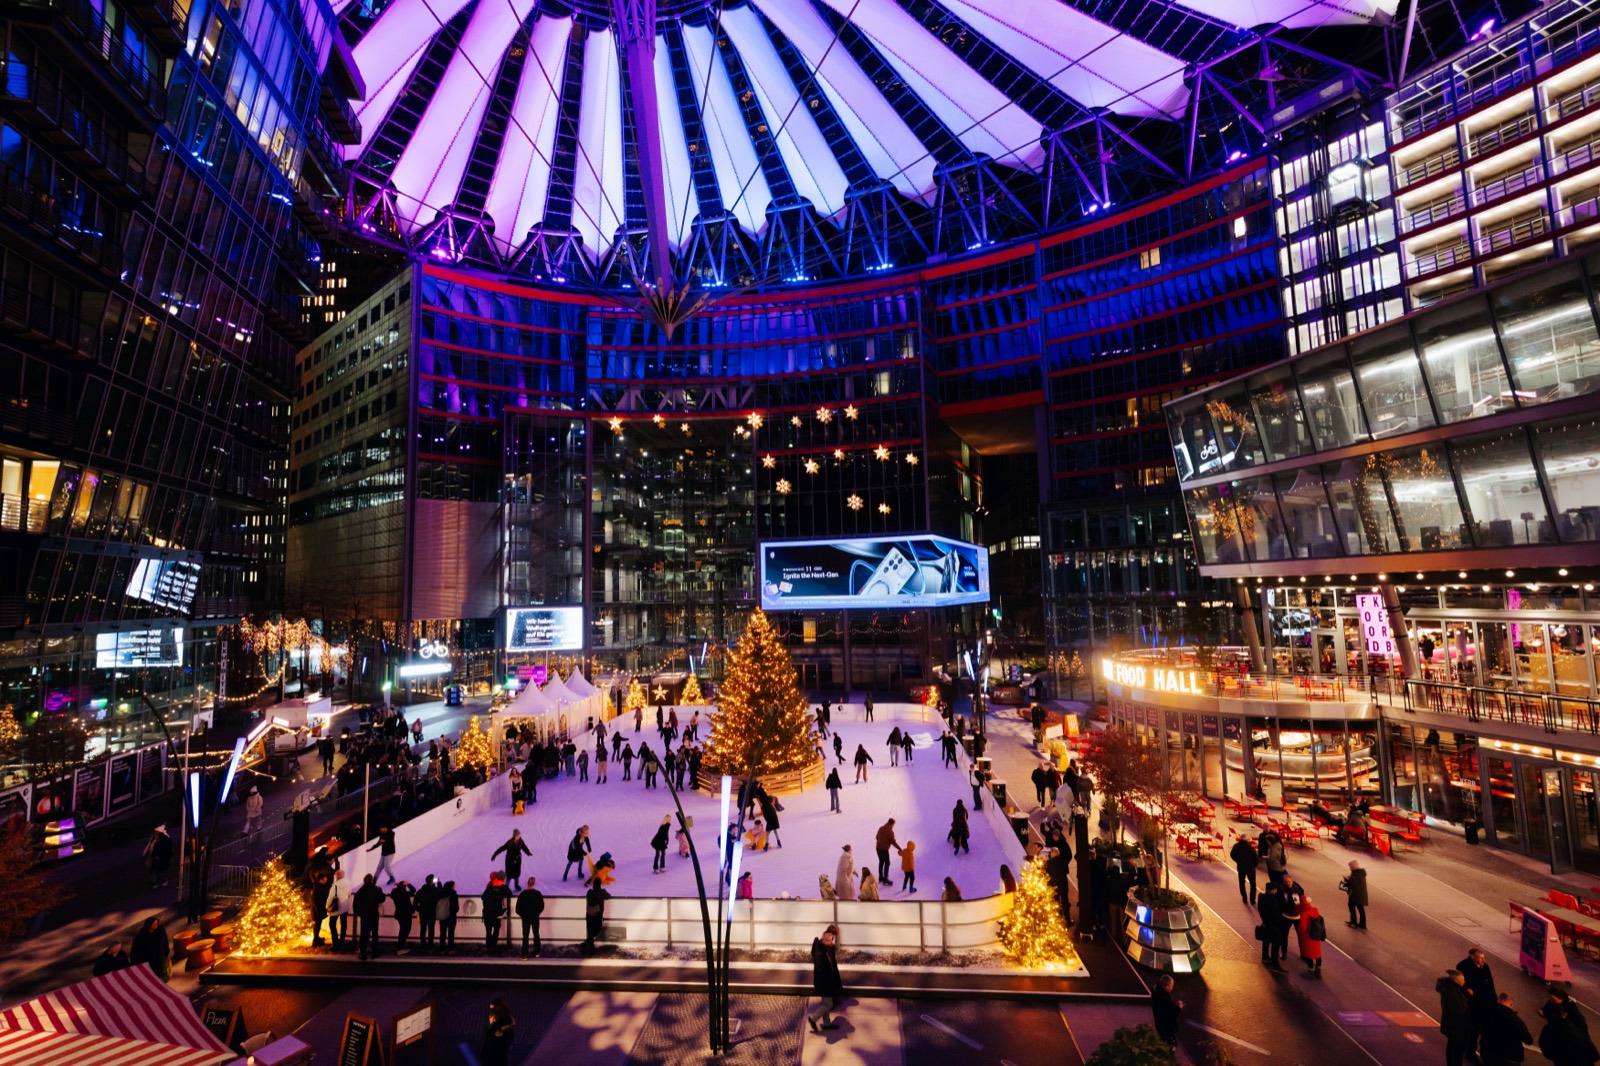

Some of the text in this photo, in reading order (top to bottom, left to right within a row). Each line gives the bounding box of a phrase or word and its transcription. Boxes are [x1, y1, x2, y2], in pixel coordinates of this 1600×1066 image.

[783, 572, 800, 580] Ignite
[811, 571, 839, 579] Next-Gen
[1115, 663, 1146, 687] FOOD
[1153, 668, 1203, 694] HALL
